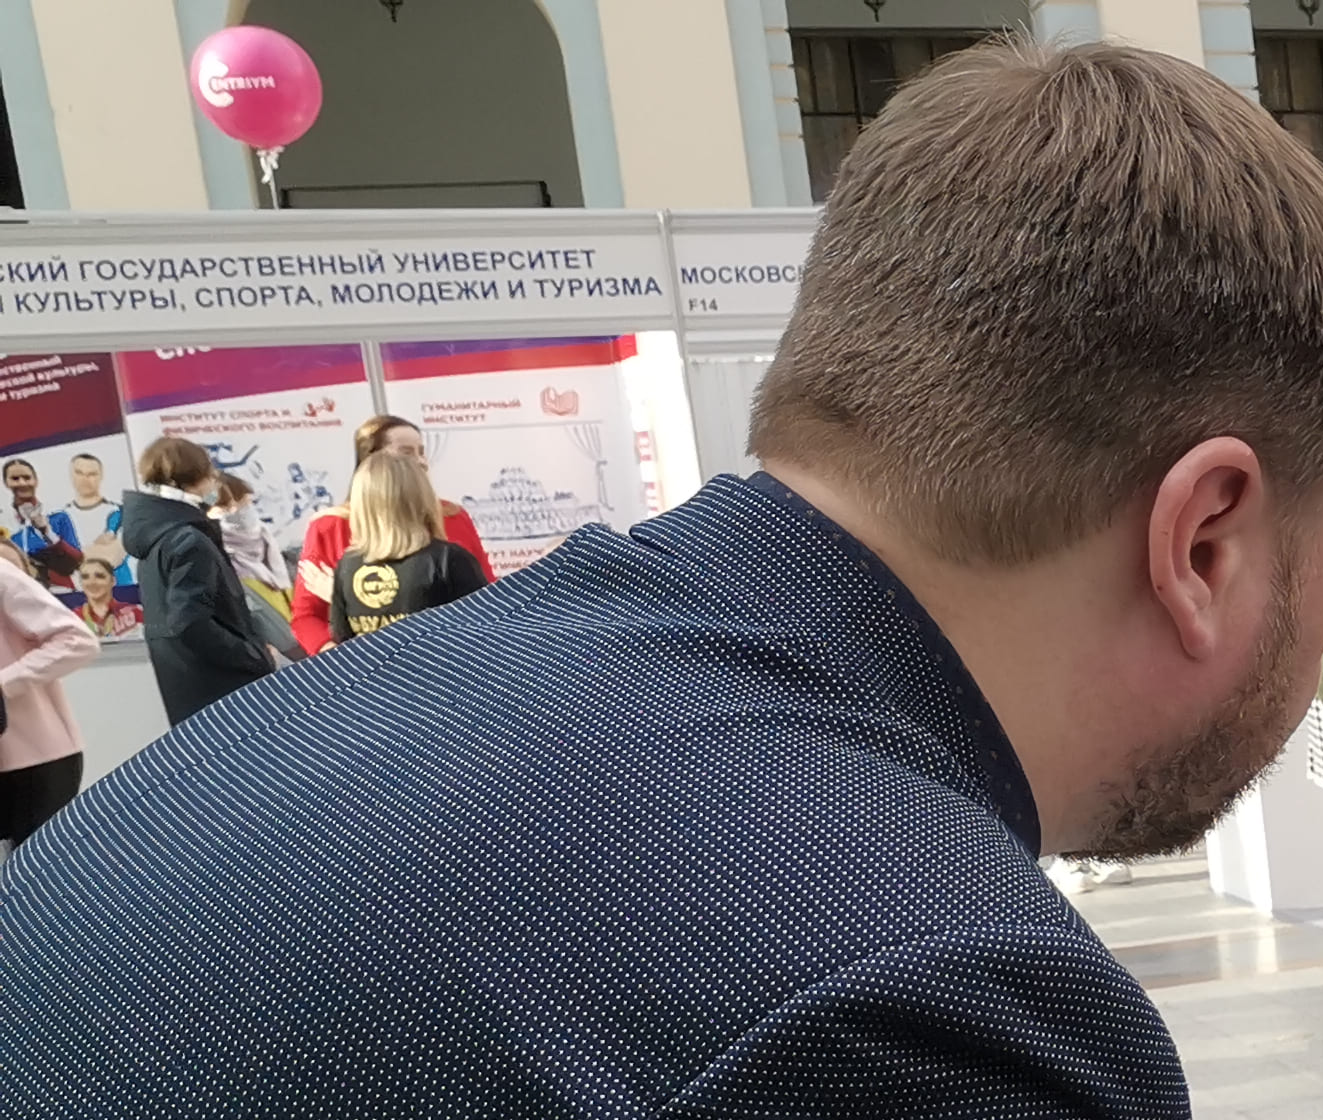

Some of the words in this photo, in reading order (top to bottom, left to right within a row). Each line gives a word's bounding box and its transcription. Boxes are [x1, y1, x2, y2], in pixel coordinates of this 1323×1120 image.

[0, 256, 68, 283] КИЙ
[79, 249, 384, 283] ГОСУДАРСТВЕННЫЙ
[392, 249, 596, 274] УНИВЕРСИТЕТ
[15, 289, 187, 314] КУЛЬТУРЫ,
[195, 285, 324, 309] СПОРТА,
[330, 279, 499, 306] МОЛОДЕЖИ
[507, 279, 526, 300] И
[533, 276, 663, 300] ТУРИЗМА
[688, 298, 719, 312] F14
